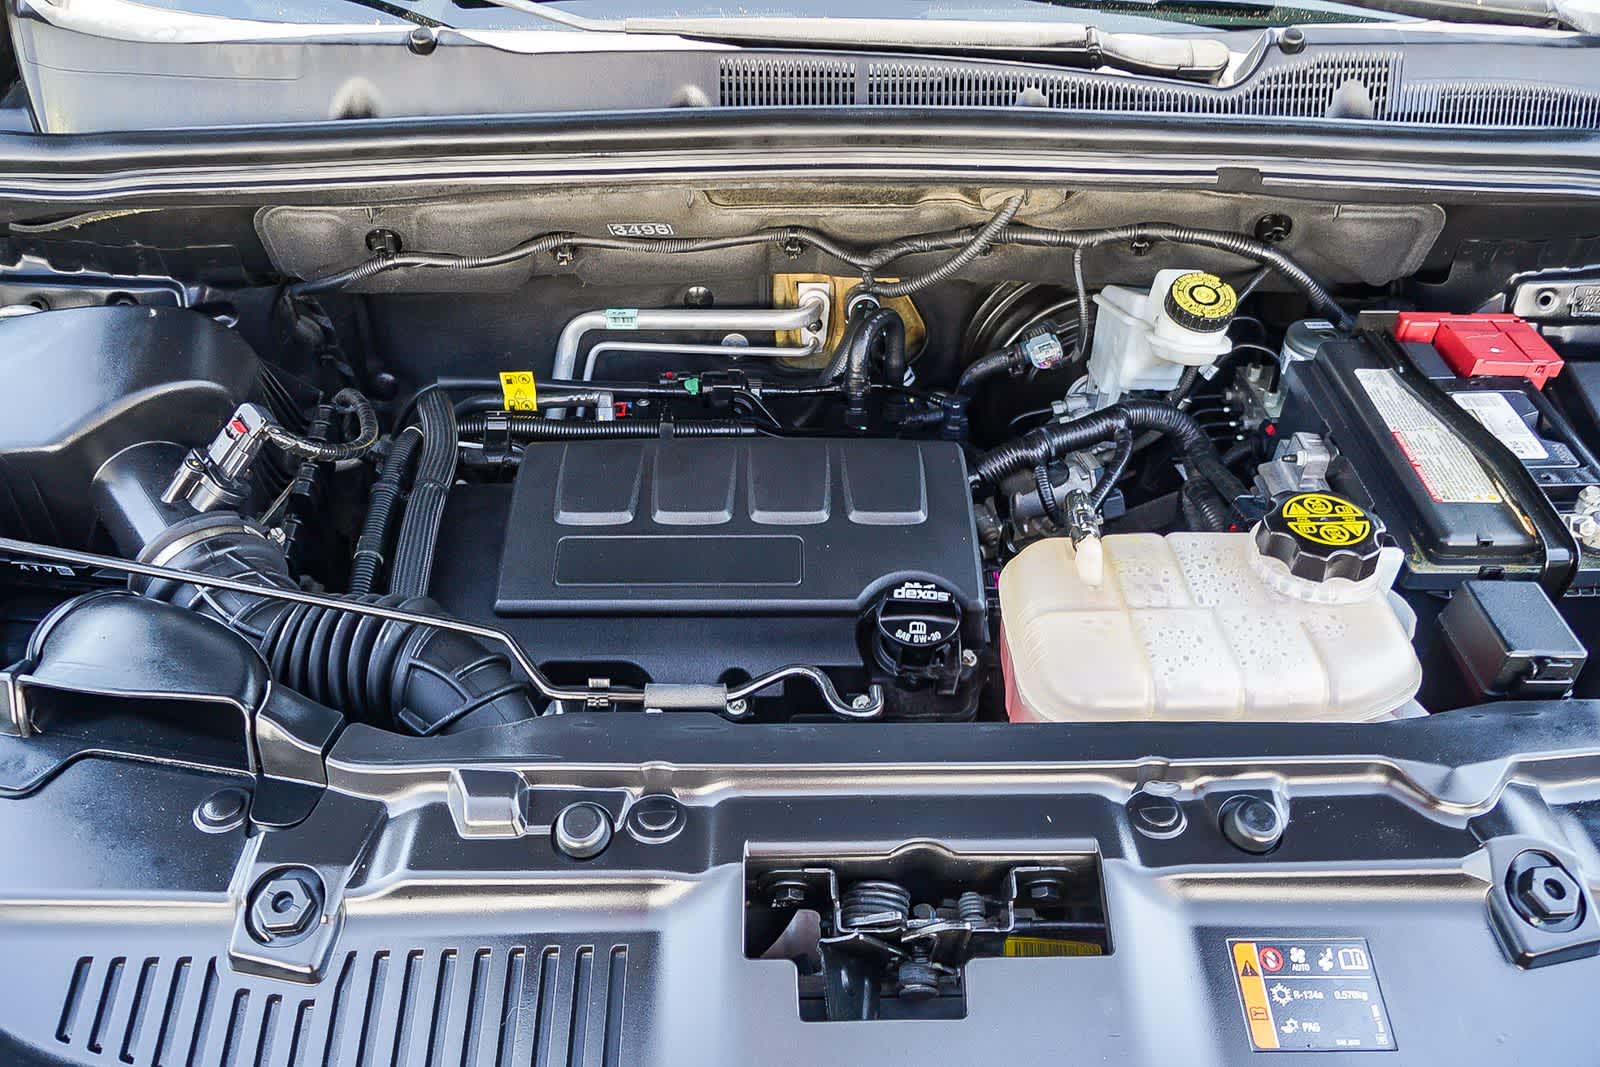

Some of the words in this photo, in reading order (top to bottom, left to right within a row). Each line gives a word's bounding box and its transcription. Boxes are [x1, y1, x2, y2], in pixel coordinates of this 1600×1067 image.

[612, 224, 669, 235] 3496
[893, 586, 949, 602] dexos
[1291, 963, 1311, 972] AUTO
